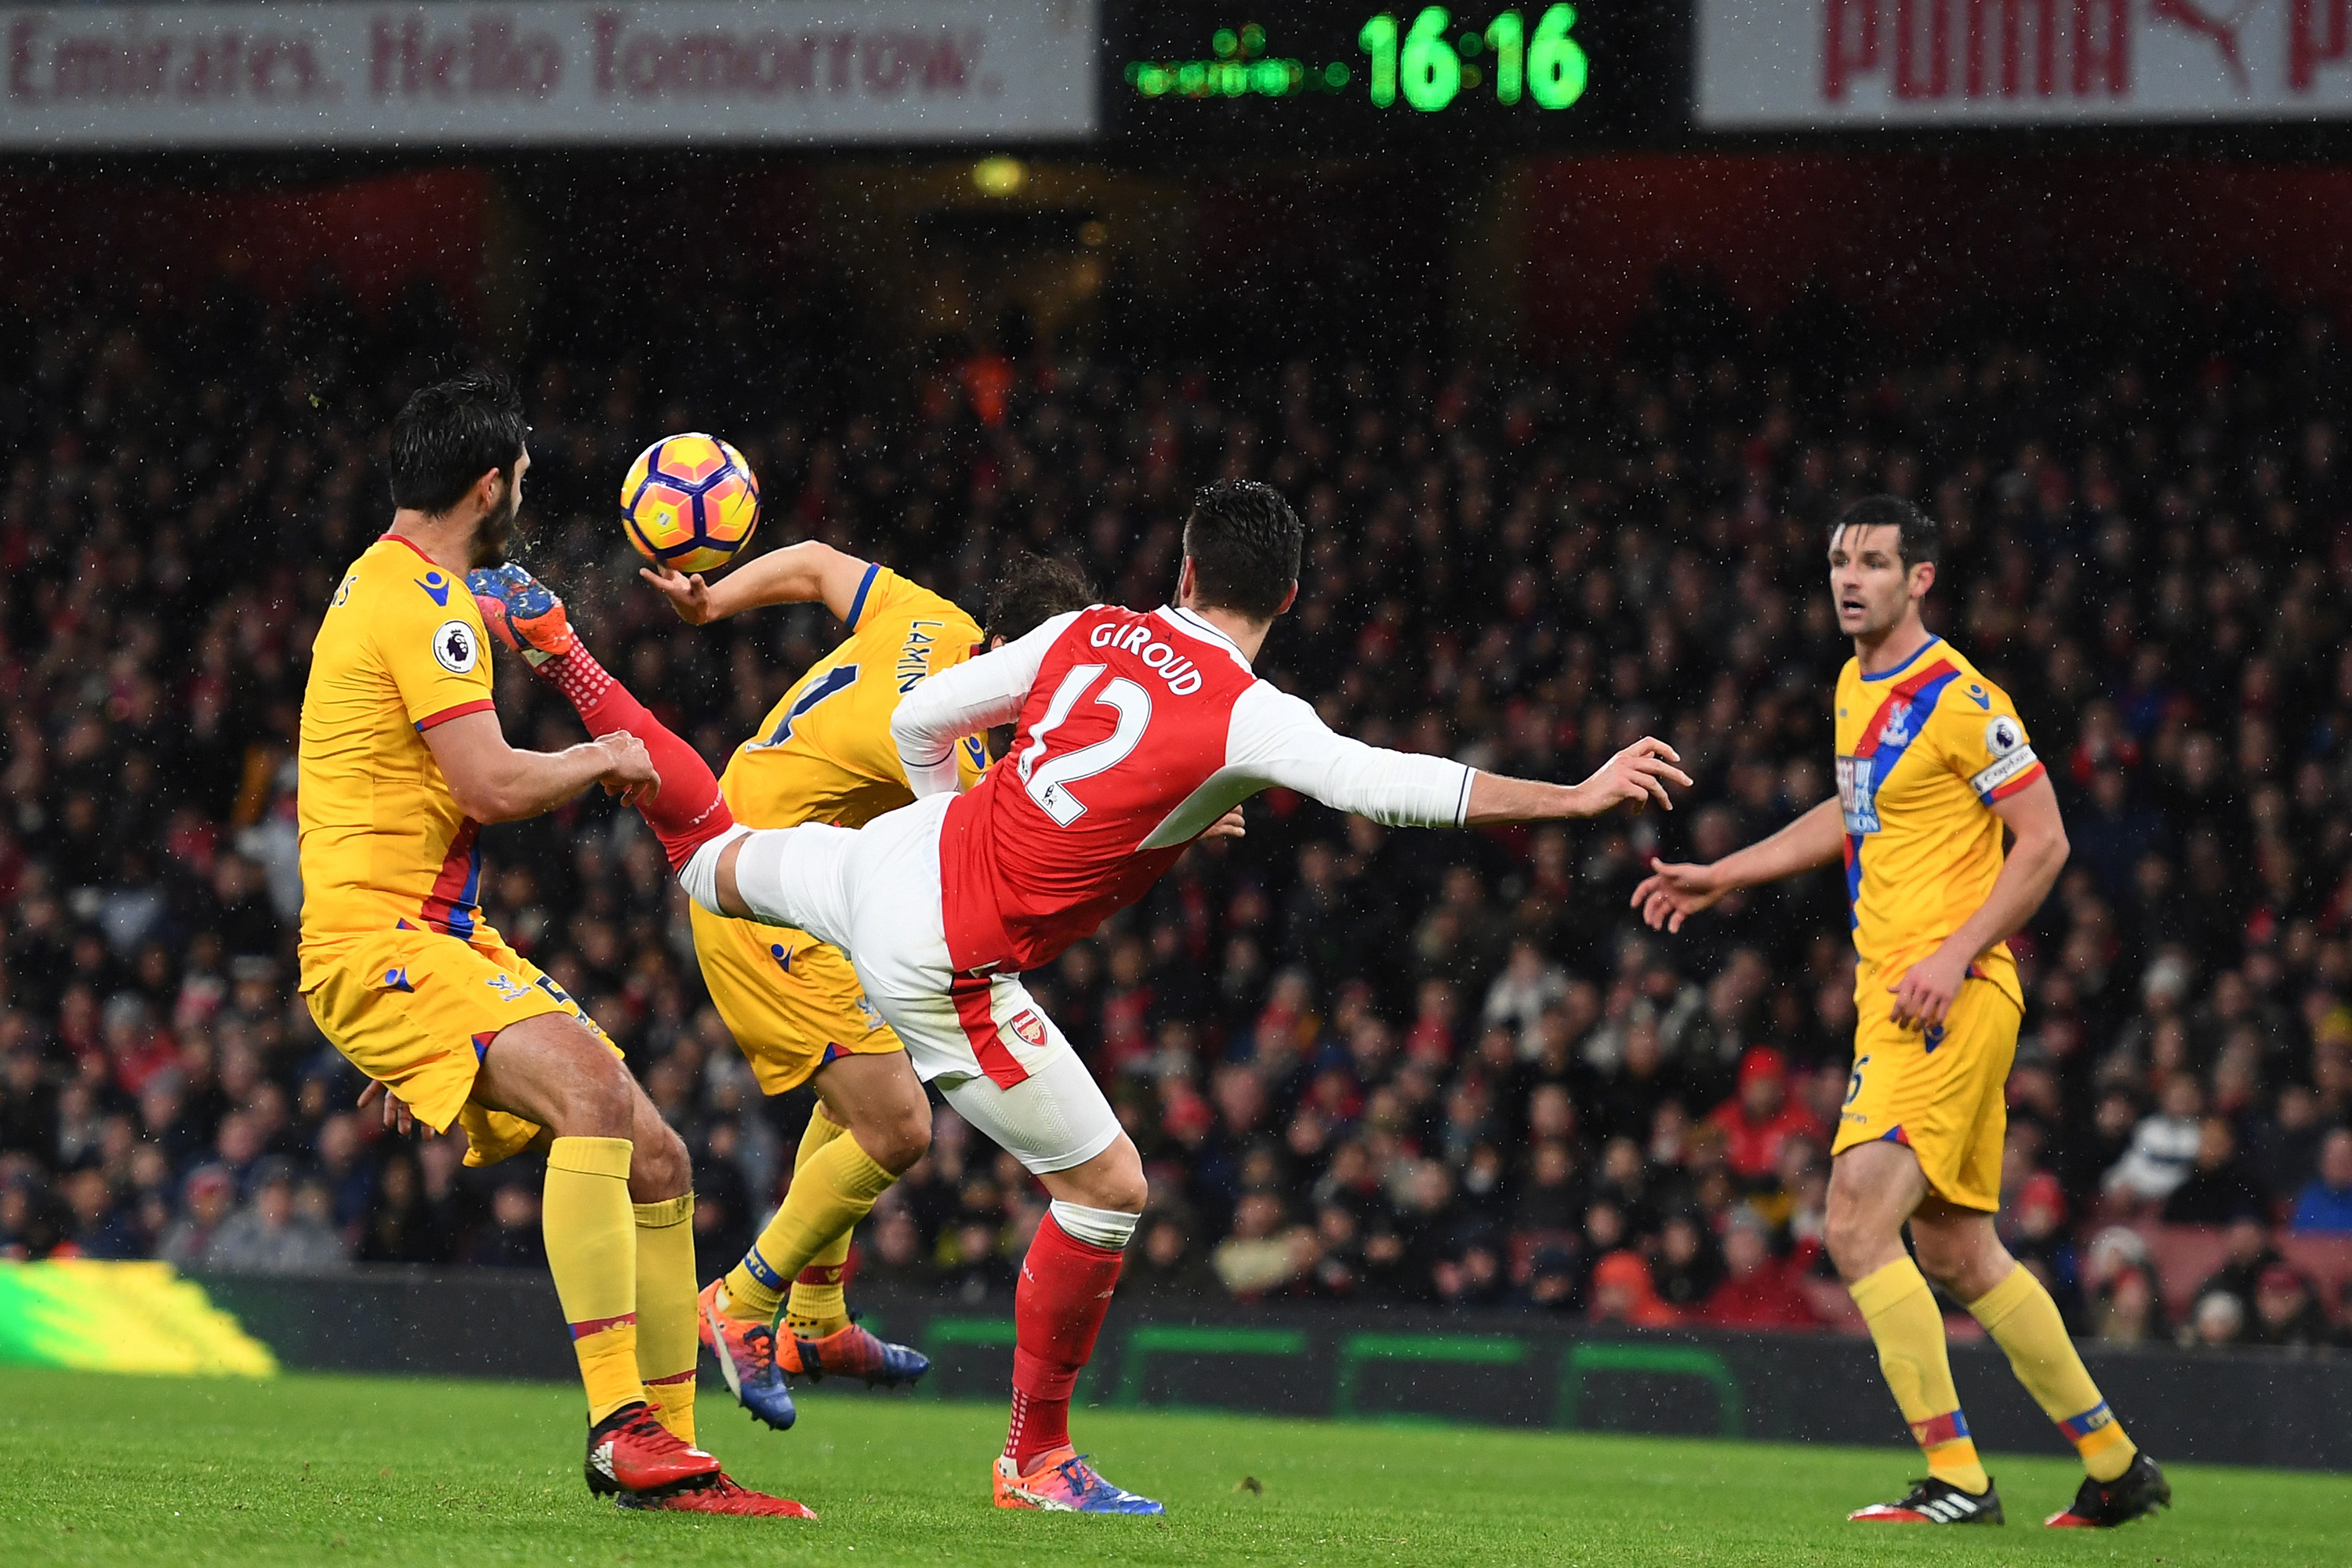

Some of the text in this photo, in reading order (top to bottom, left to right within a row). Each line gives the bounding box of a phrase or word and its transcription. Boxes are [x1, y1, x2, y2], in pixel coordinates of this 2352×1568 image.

[367, 10, 562, 103] Hello
[592, 9, 1004, 100] Tomorrow.
[1090, 622, 1203, 696] GIROUD
[1016, 663, 1152, 828] 12
